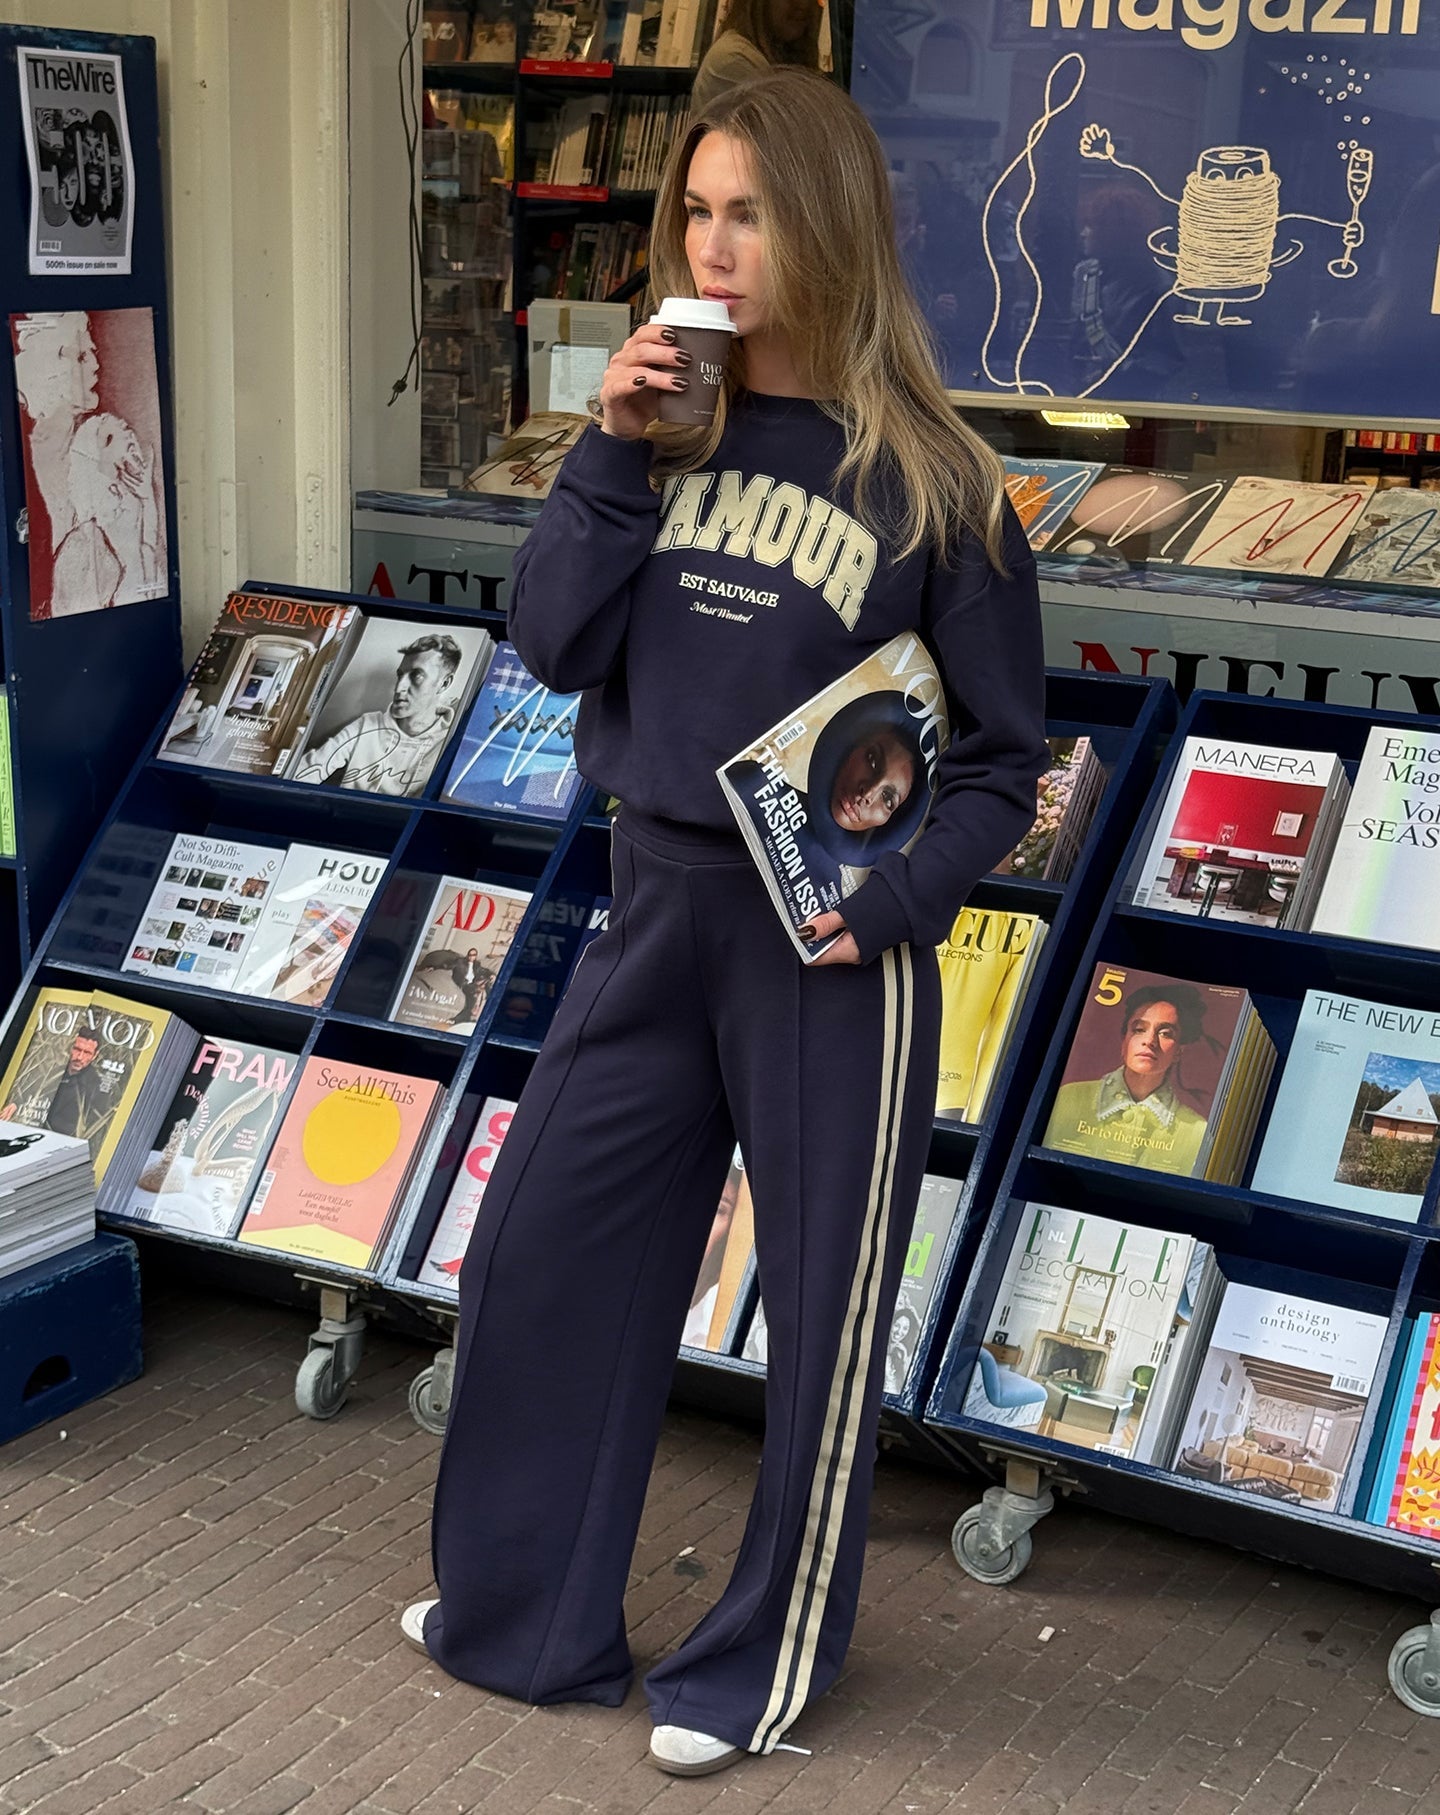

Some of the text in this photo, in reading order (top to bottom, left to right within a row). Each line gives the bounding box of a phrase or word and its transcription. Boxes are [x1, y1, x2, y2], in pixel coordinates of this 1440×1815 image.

[28, 58, 116, 95] TheWire
[45, 260, 66, 269] 500th
[67, 261, 84, 269] issue
[93, 261, 106, 269] sale
[679, 571, 780, 608] EST SAUVAGE
[689, 601, 754, 624] Most Wanted
[1194, 745, 1317, 777] MANERA
[756, 744, 808, 834] THE BIG
[177, 838, 197, 848] Not
[198, 841, 212, 853] So
[753, 783, 806, 881] FASHION
[174, 850, 245, 872] Cult Magazine
[763, 835, 787, 881] MICHAELA
[435, 890, 496, 933] AD
[947, 909, 1034, 956] GUE
[1094, 972, 1126, 1006] 5
[1315, 996, 1359, 1023] THE
[1365, 1007, 1423, 1034] NEW
[317, 1067, 417, 1106] See All This
[1077, 1120, 1175, 1152] Ear to the ground
[1024, 1208, 1180, 1286] ELLE
[1047, 1229, 1067, 1244] NL
[1018, 1253, 1169, 1304] DECORATION
[1259, 1313, 1341, 1344] anthology
[1277, 1303, 1331, 1327] design
